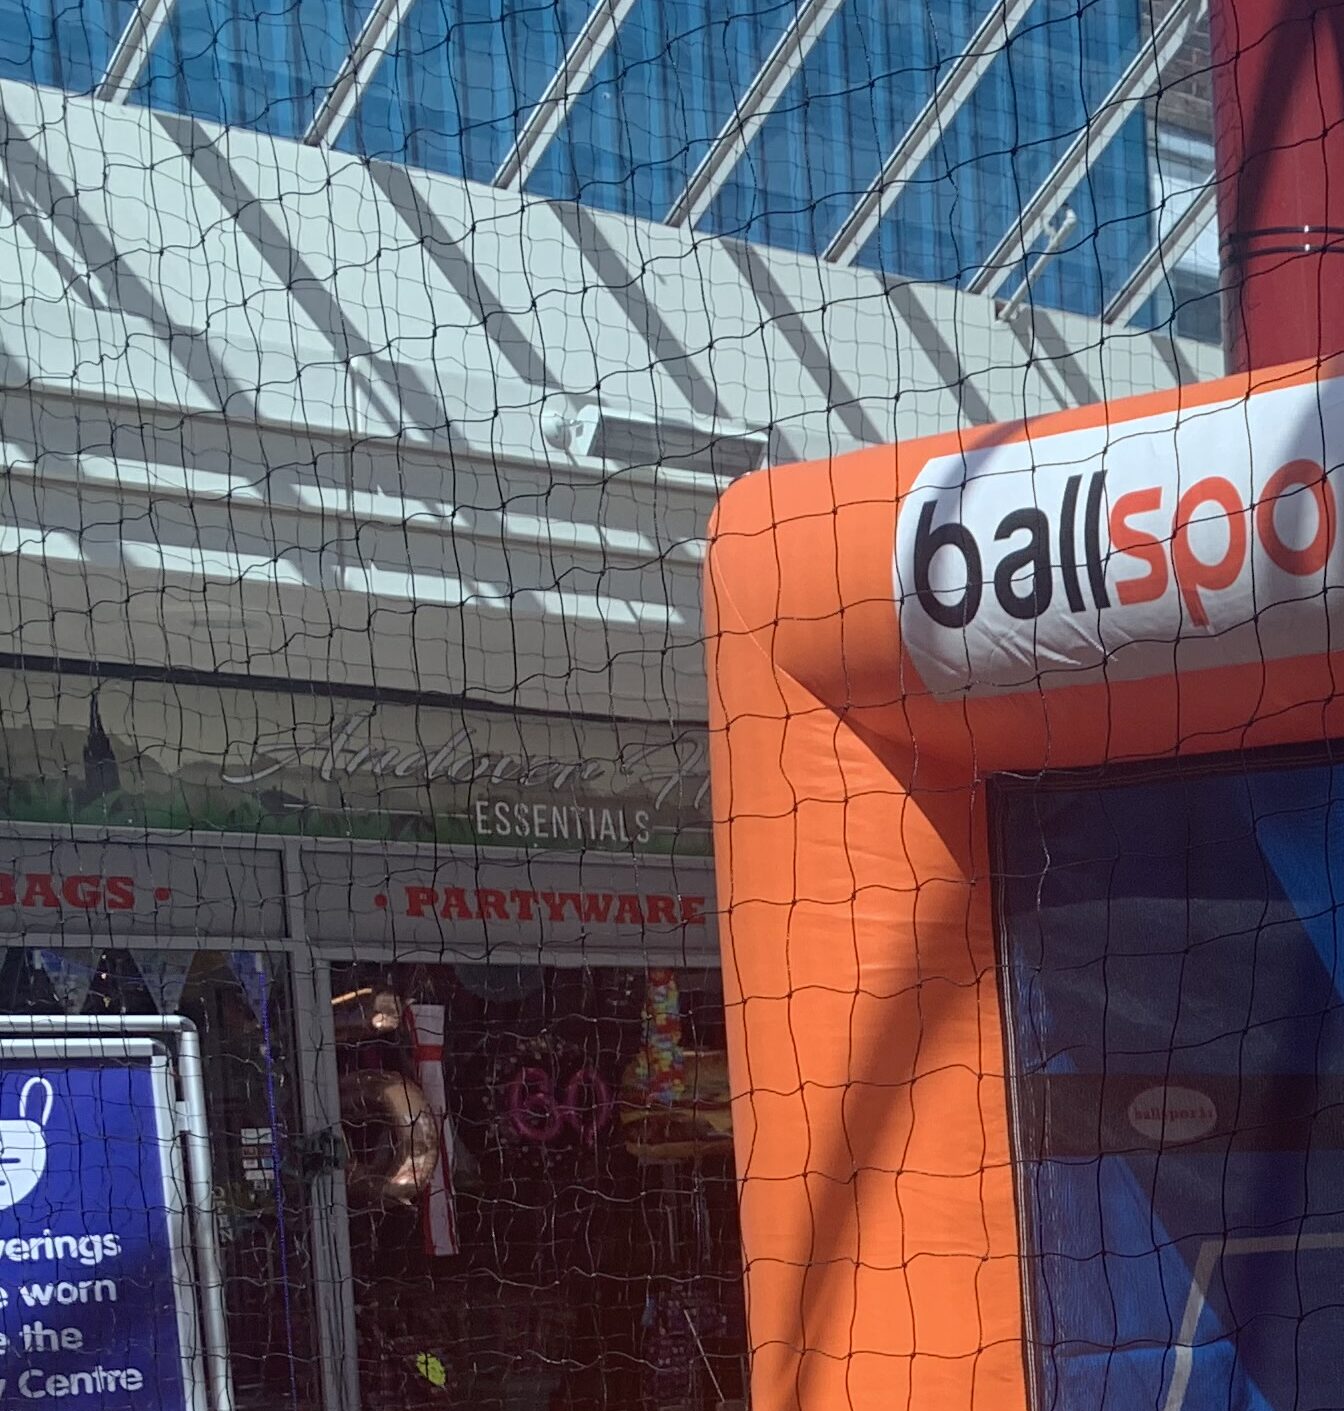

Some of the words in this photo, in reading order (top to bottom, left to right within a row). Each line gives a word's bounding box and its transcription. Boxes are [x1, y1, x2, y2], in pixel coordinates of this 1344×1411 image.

[475, 800, 650, 844] ESSENTIALS
[405, 886, 706, 926] PARTYWARE
[0, 1228, 122, 1266] erings
[19, 1278, 117, 1307] worn
[22, 1320, 84, 1352] the
[18, 1365, 144, 1399] Centre
